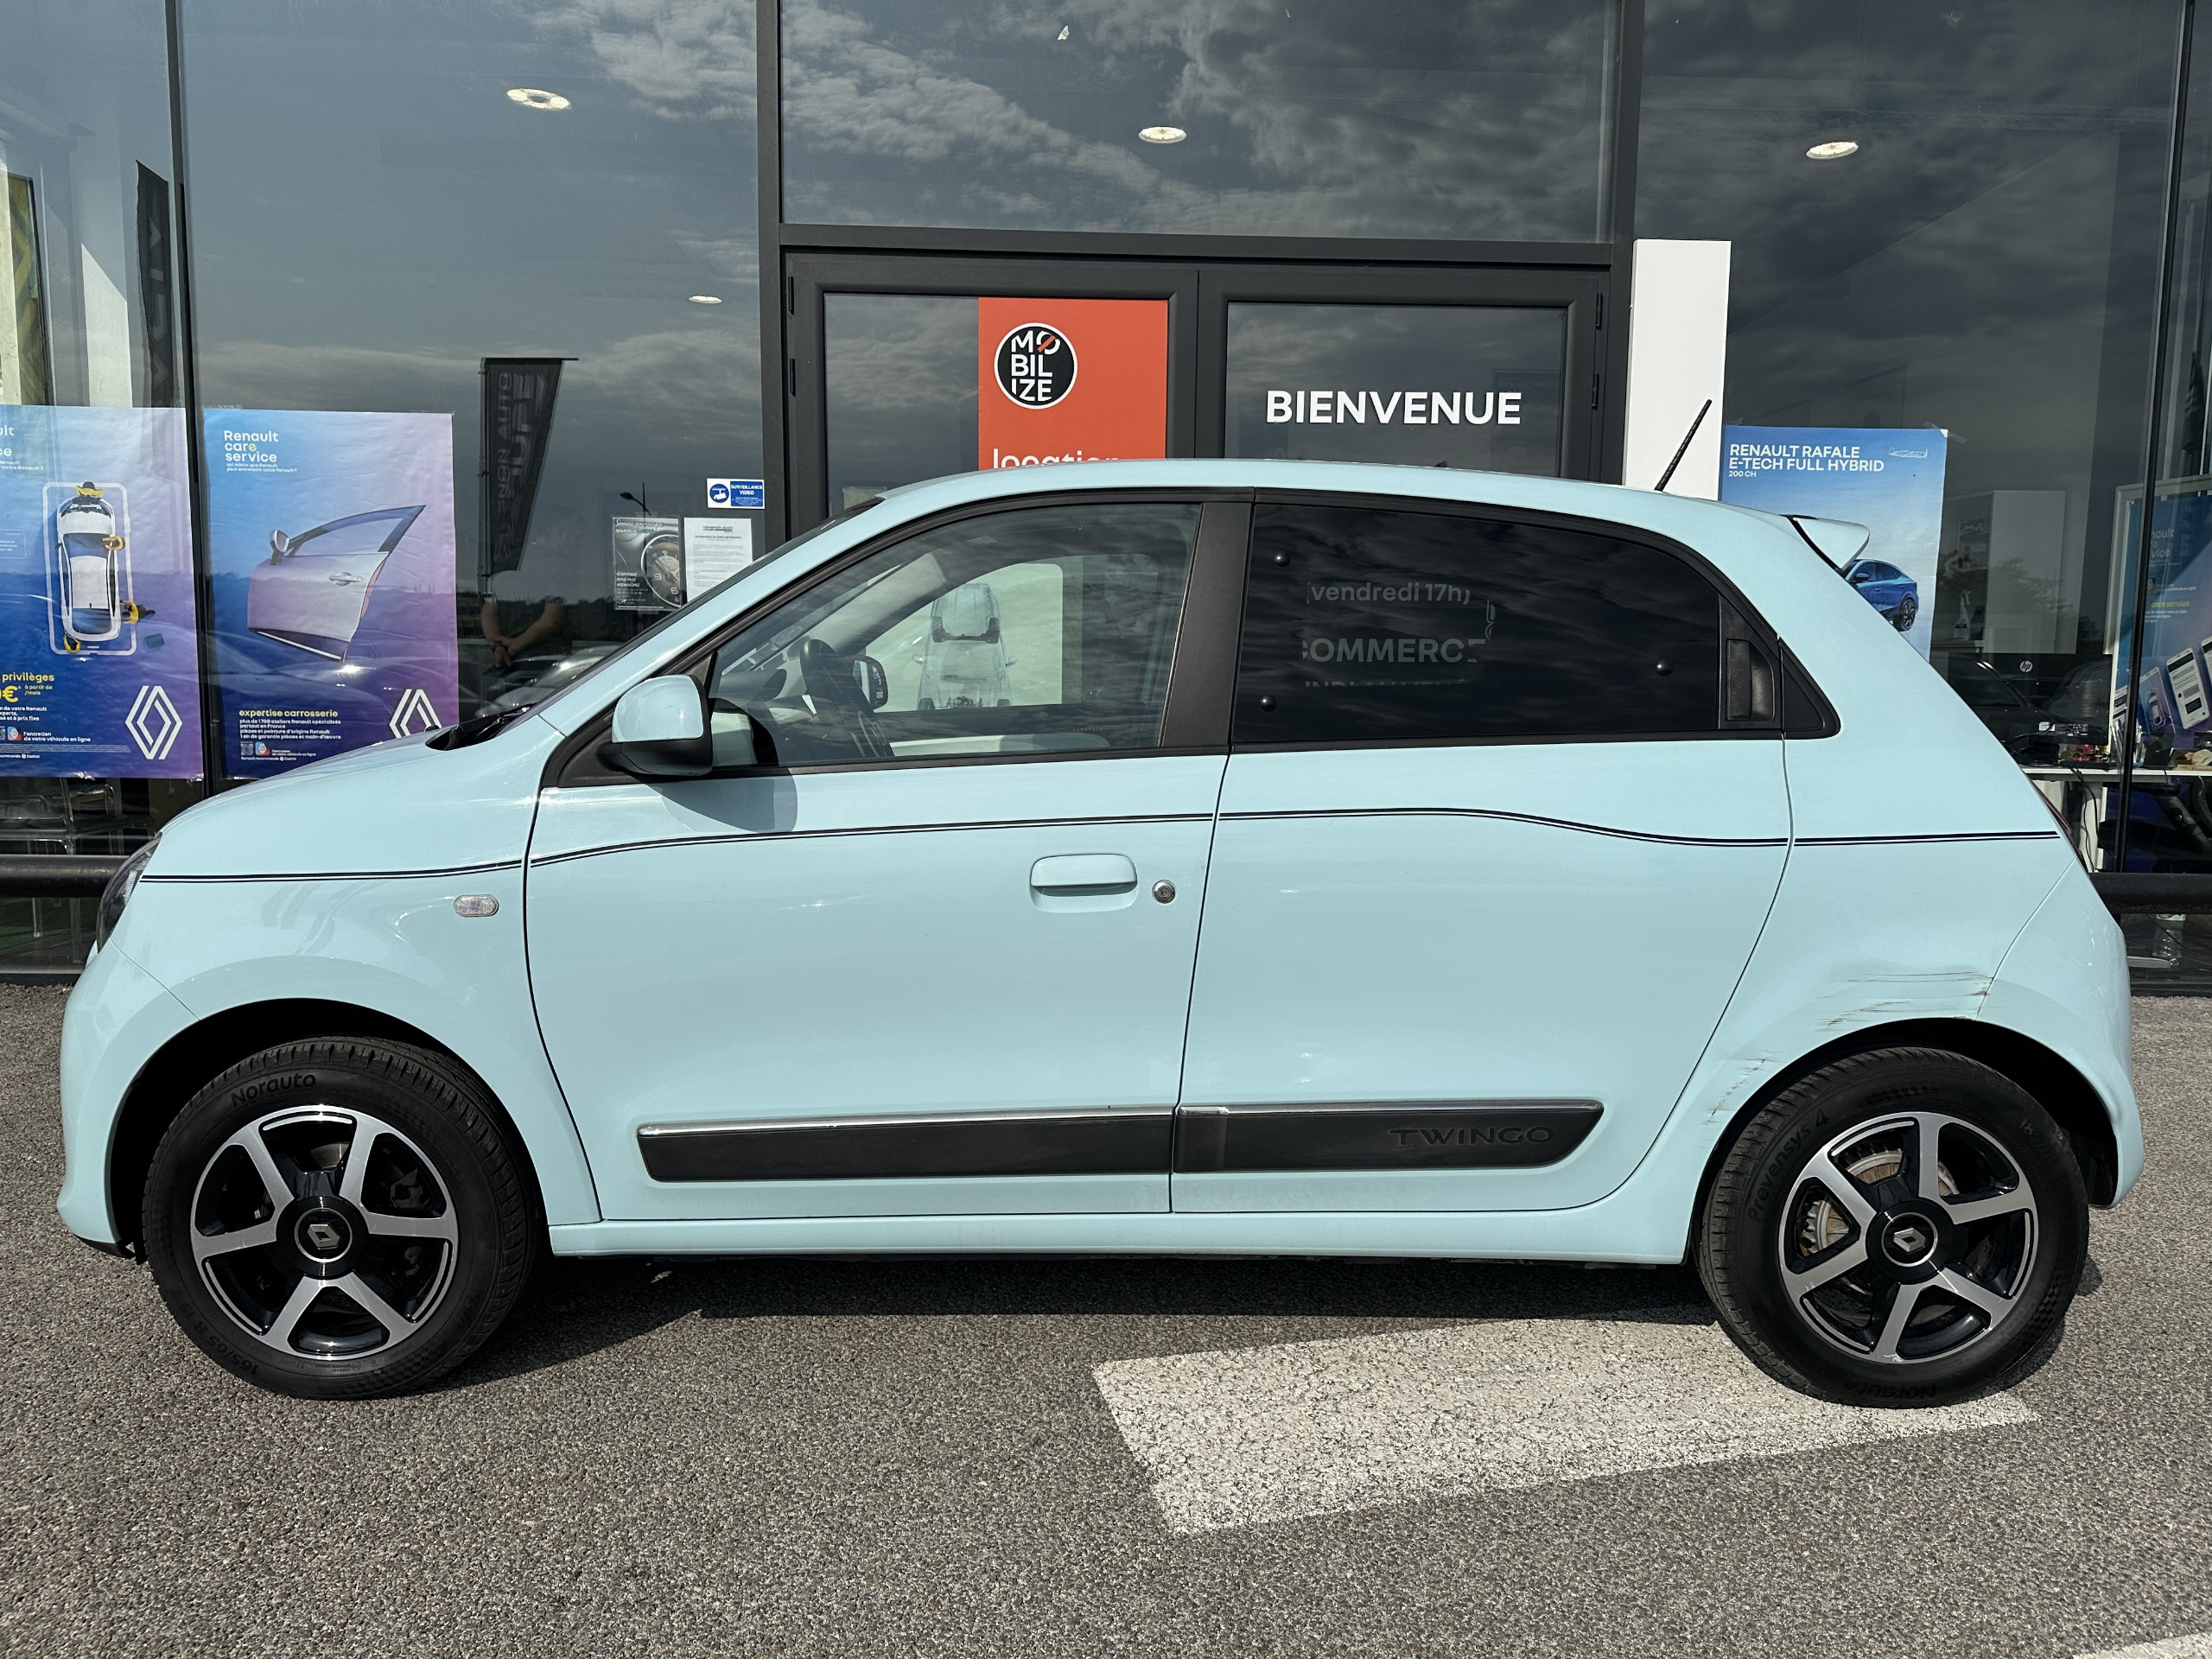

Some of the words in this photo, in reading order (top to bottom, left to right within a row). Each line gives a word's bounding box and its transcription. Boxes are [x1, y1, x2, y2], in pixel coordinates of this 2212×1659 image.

[1266, 390, 1522, 425] BIENVENUE
[223, 429, 279, 442] Renault
[225, 442, 257, 452] care
[1730, 443, 1800, 458] RENAULT
[1802, 446, 1860, 459] RAFALE
[225, 451, 277, 462] service
[1728, 457, 1783, 470] E-TECH
[1786, 459, 1825, 471] FULL
[1827, 459, 1885, 472] HYBRID
[2, 672, 55, 683] privilèges
[238, 709, 283, 718] expertise
[231, 1072, 316, 1107] Norauto
[1389, 1126, 1554, 1145] TWINGO
